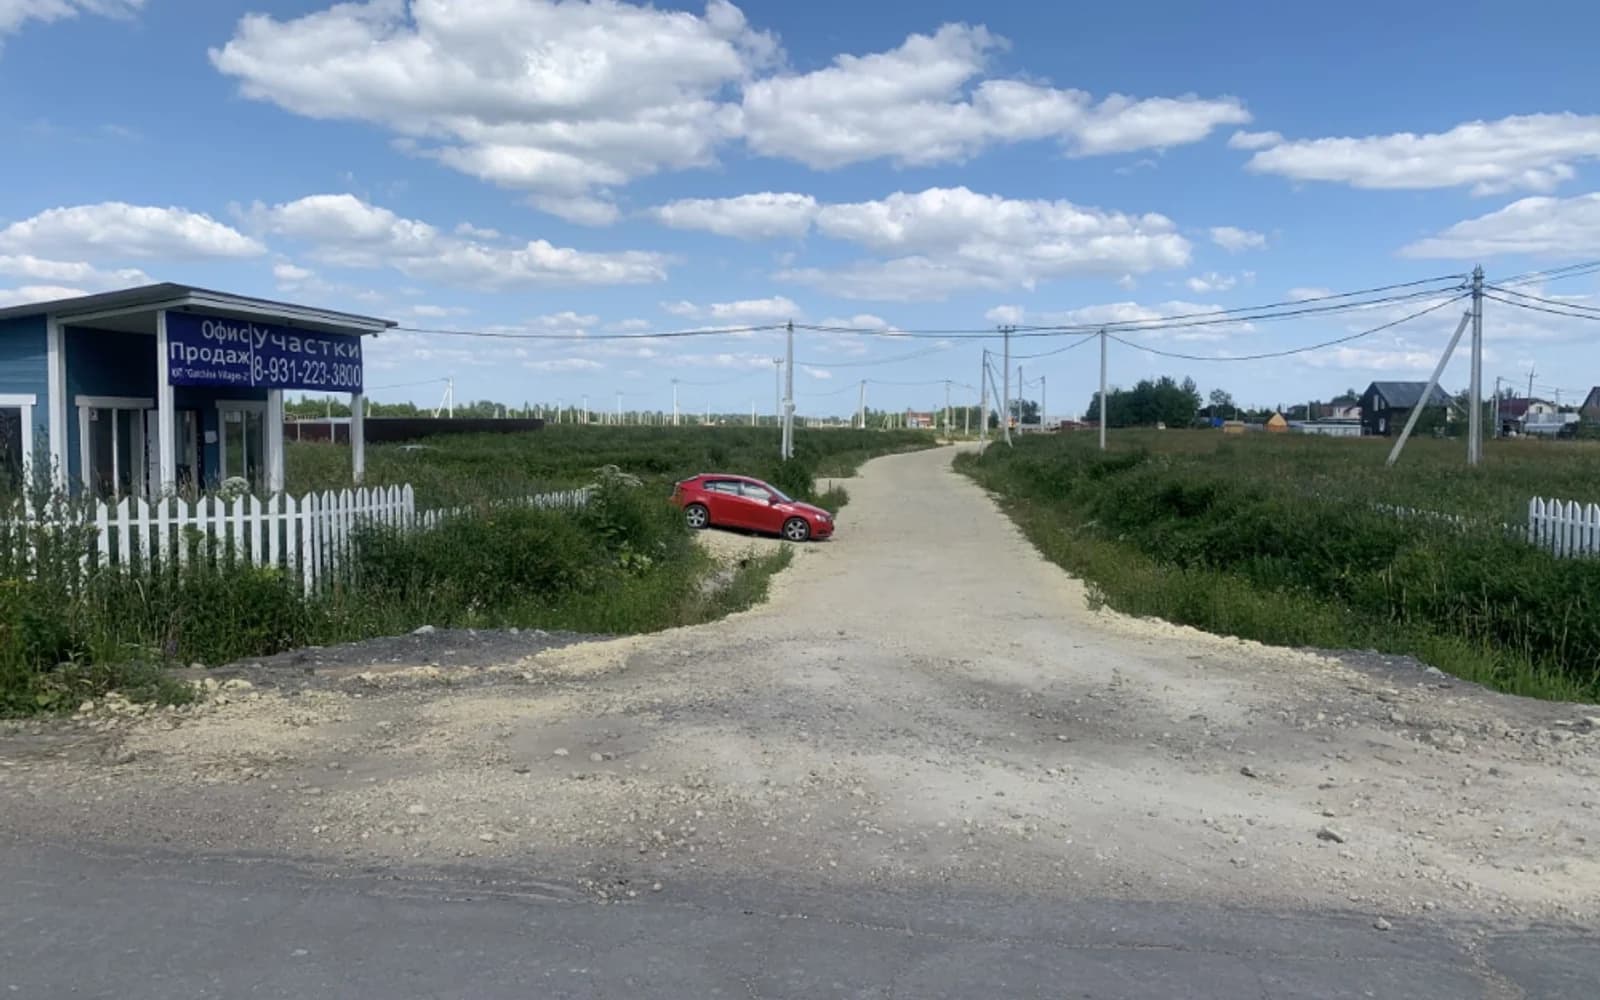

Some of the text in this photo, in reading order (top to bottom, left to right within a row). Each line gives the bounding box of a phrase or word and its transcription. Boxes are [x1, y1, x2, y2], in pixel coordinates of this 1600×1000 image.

[202, 320, 249, 344] Офис
[253, 328, 360, 358] Участки
[170, 342, 250, 365] Продаж
[254, 356, 361, 387] 8-931-223-3800
